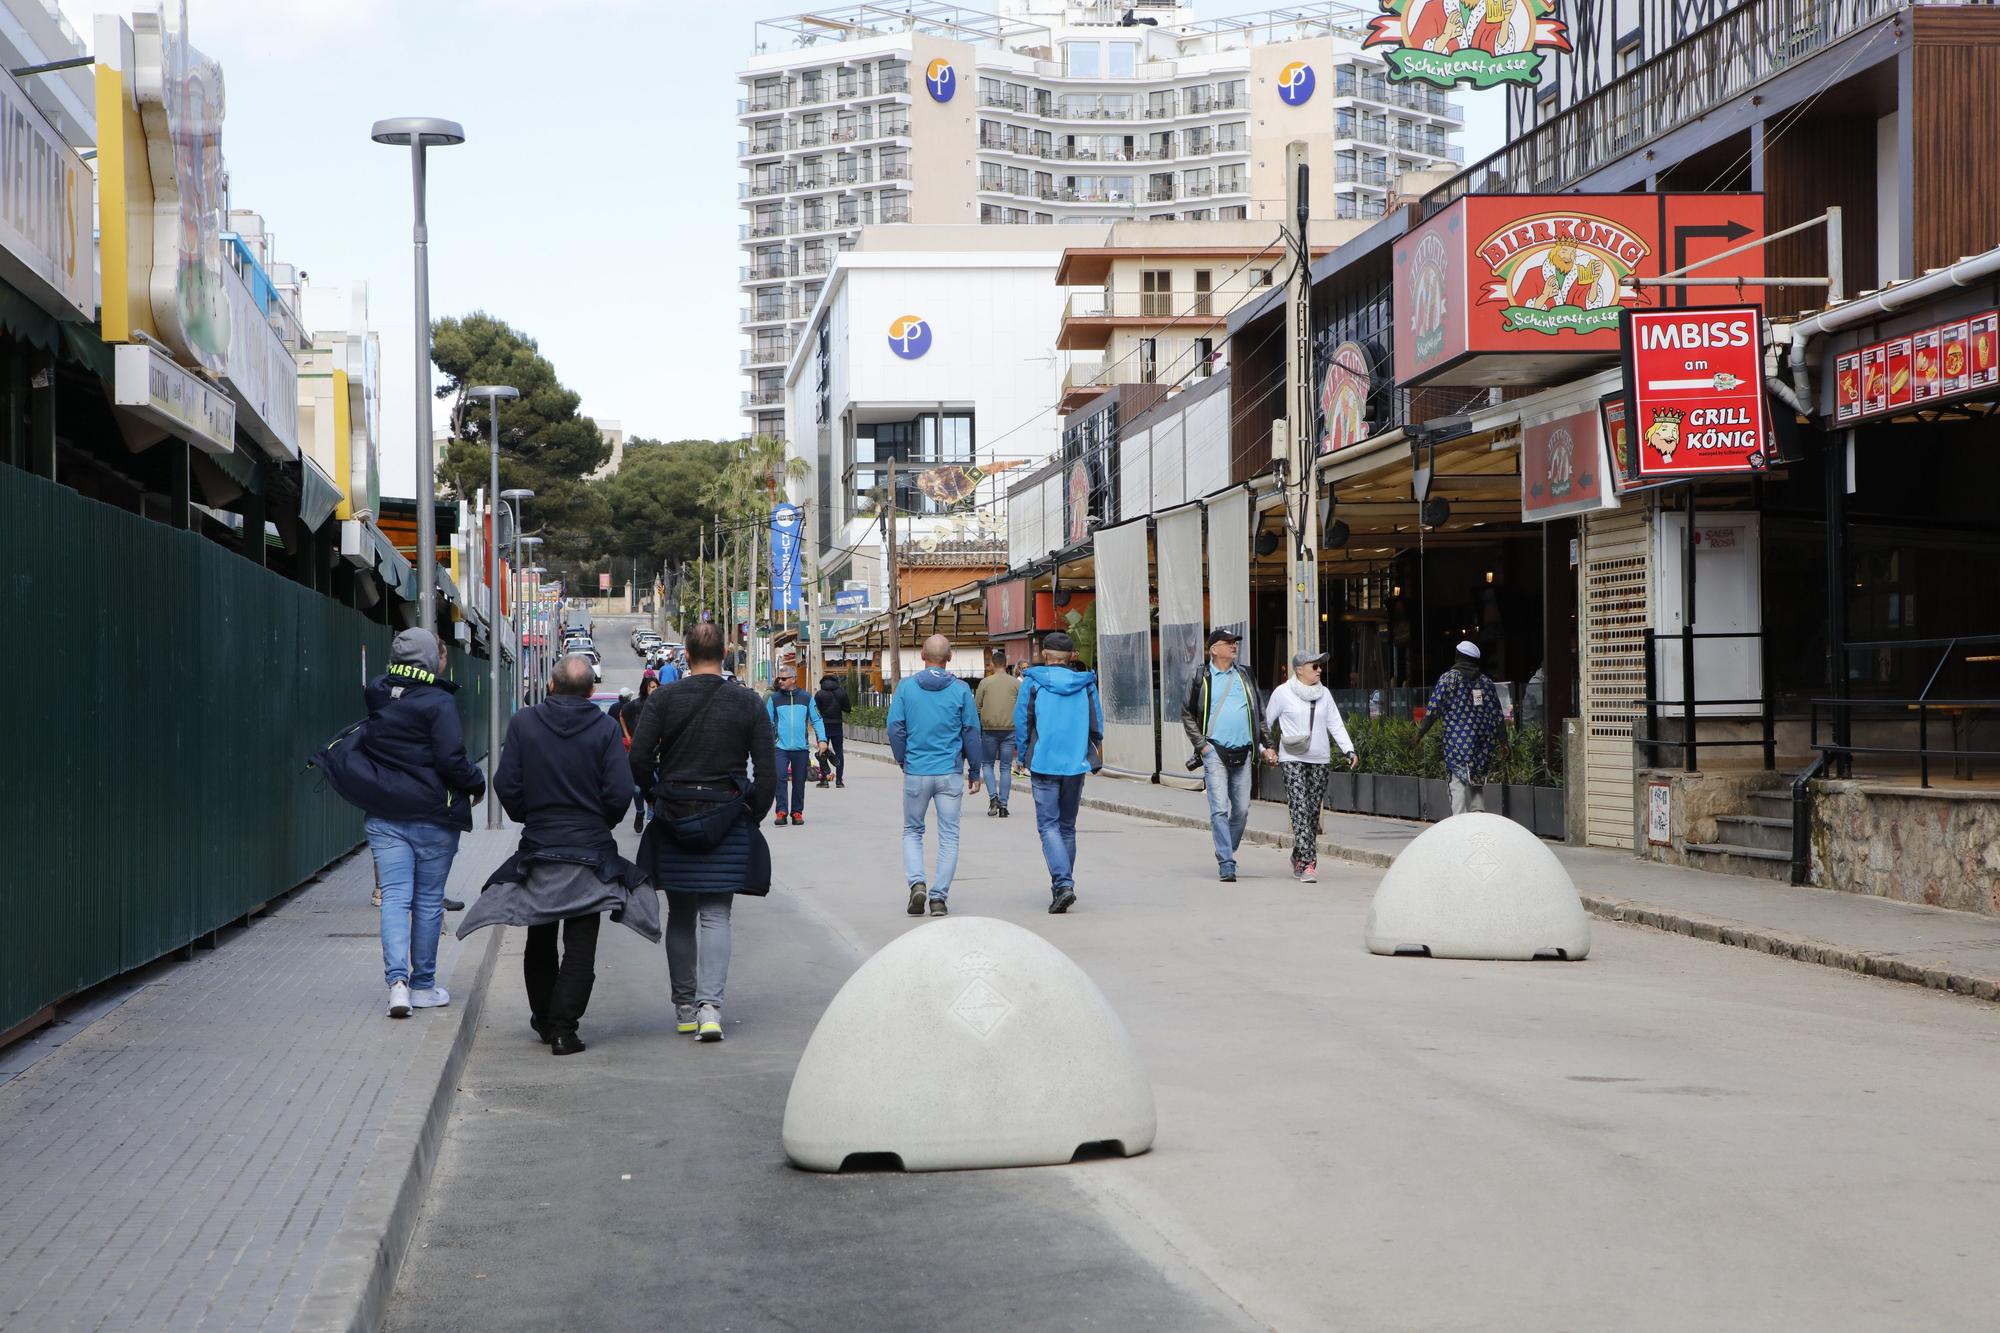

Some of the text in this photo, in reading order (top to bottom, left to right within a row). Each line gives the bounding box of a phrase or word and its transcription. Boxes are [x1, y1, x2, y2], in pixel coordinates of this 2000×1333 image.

[1482, 217, 1643, 267] BIERKÖNIG
[1640, 321, 1750, 350] IMBISS
[1684, 359, 1709, 371] am
[1689, 407, 1751, 426] GRILL
[1686, 428, 1757, 450] KÖNIG
